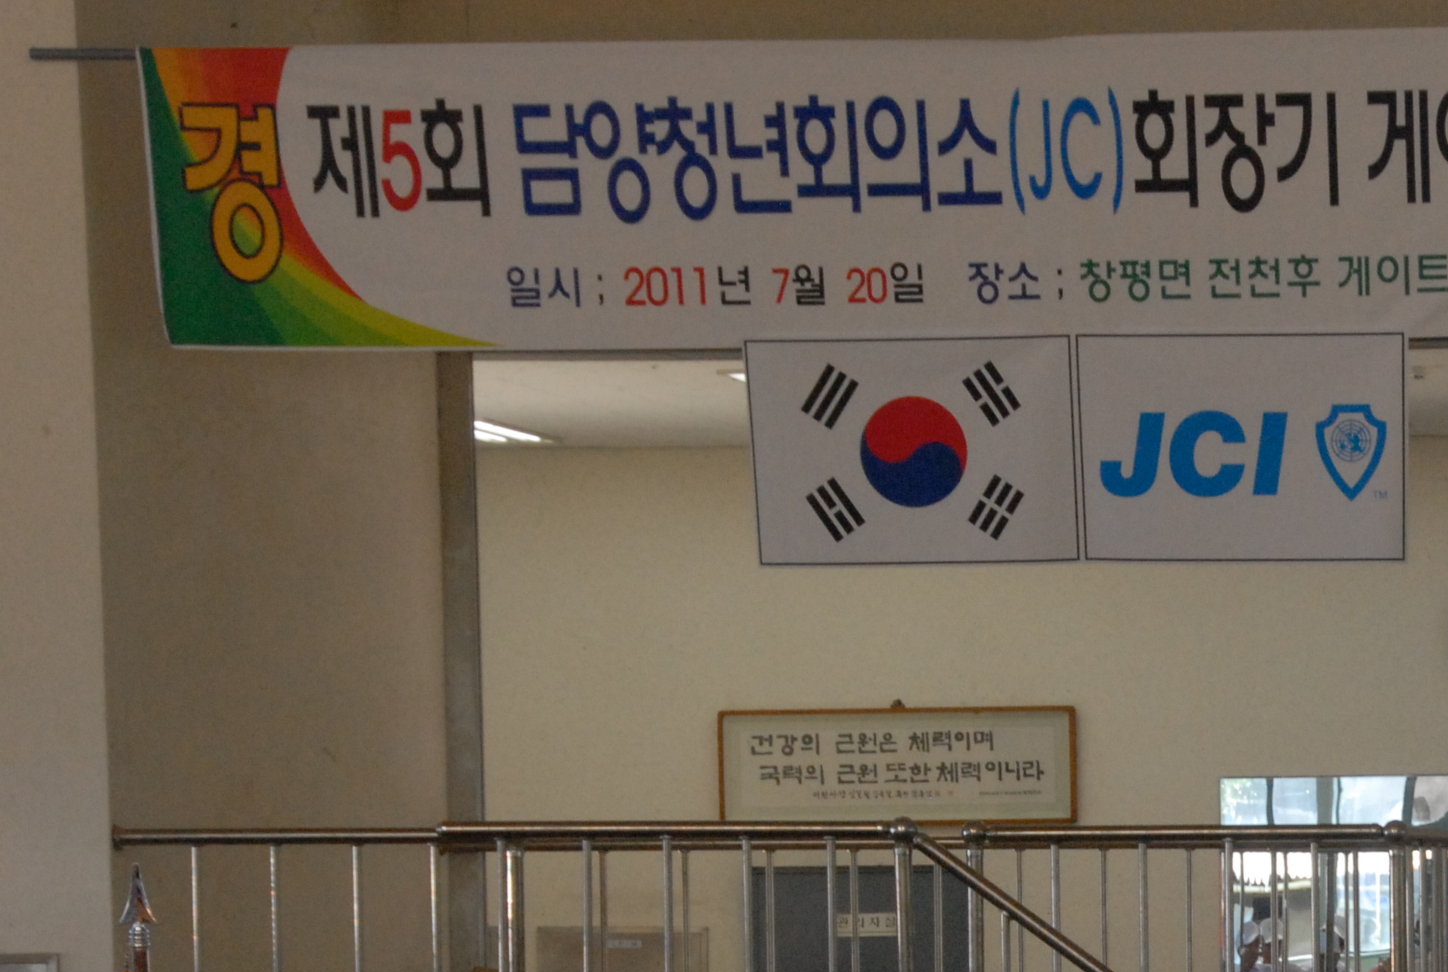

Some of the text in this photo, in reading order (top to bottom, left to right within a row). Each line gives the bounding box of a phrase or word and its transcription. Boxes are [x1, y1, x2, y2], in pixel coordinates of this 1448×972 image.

[304, 97, 492, 218] 제5회
[177, 102, 284, 284] 경
[623, 264, 752, 307] 2011년
[771, 263, 826, 307] 7월
[846, 261, 924, 305] 20일
[1079, 258, 1191, 303] 창평면
[1208, 254, 1321, 299] 전천후
[1100, 410, 1288, 497] JCI
[750, 729, 995, 756] 건강의 근원은 체력이며
[759, 758, 1045, 786] 국력의 근원 또한 체력이니라
